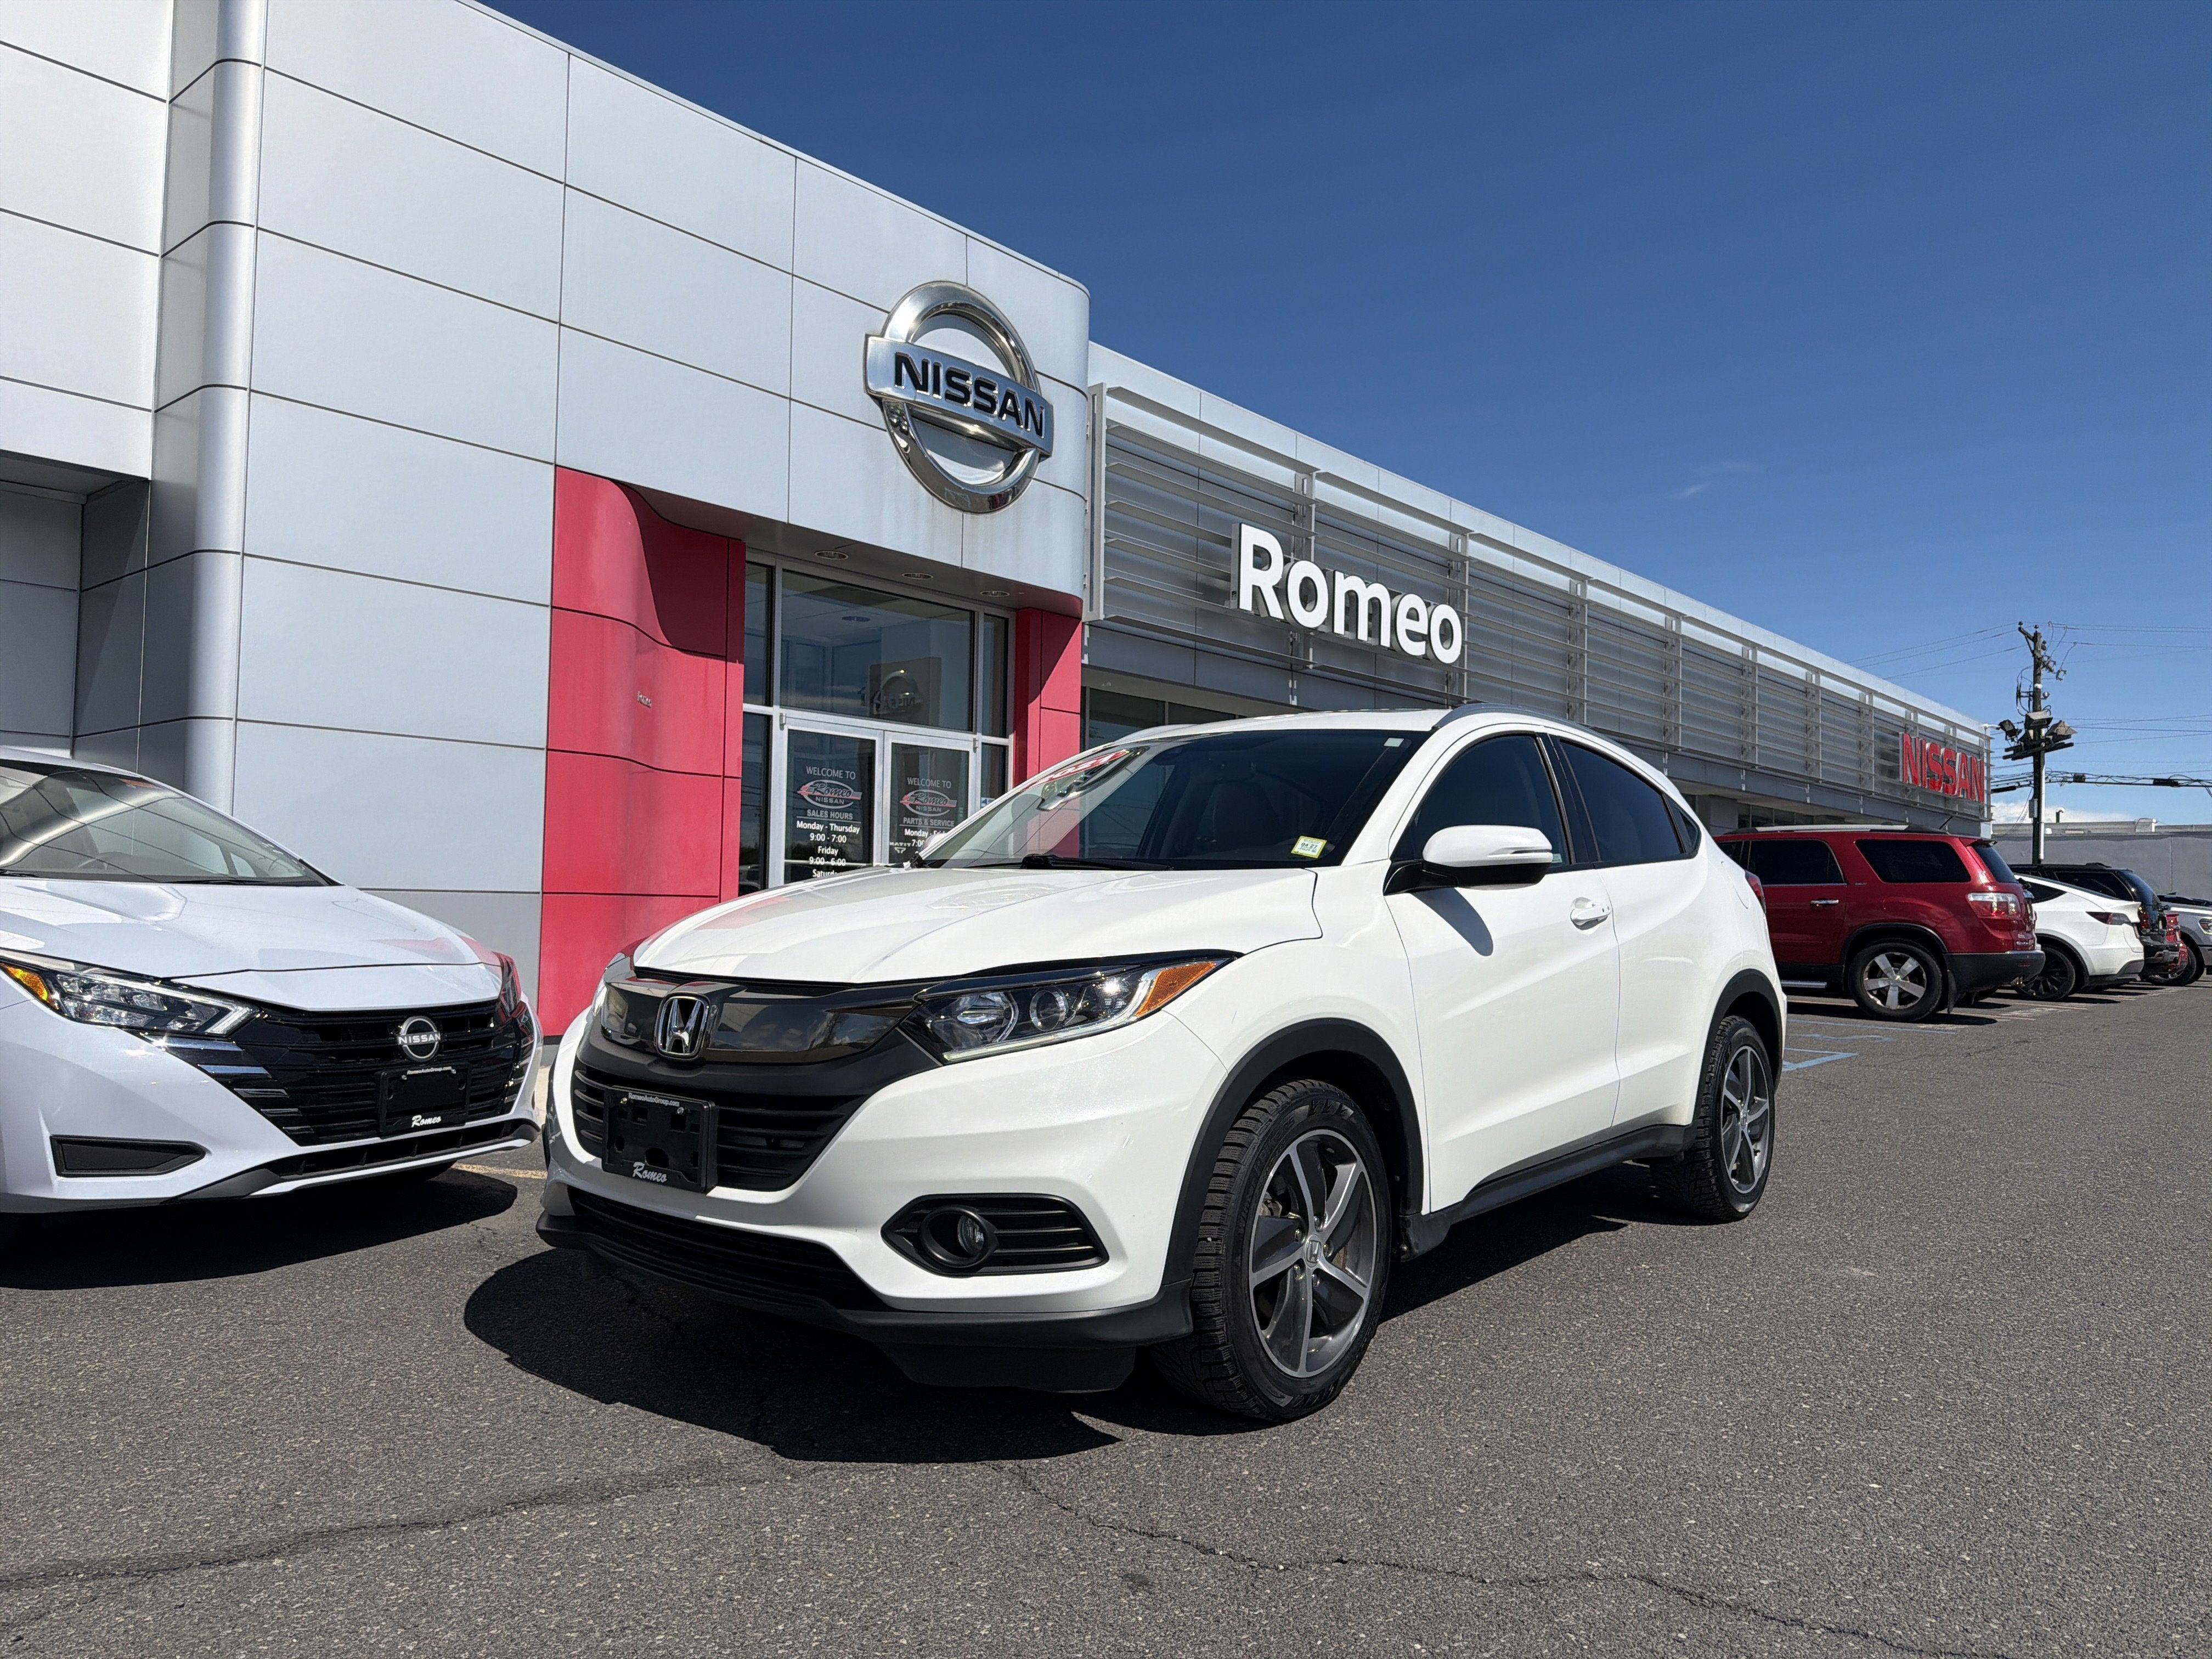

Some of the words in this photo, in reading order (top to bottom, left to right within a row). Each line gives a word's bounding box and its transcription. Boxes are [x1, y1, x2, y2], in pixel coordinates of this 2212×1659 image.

[894, 351, 1045, 439] NISSAN
[1238, 522, 1463, 664] Romeo
[806, 766, 843, 778] WELCOME
[845, 770, 856, 780] TO
[1902, 732, 1985, 803] NISSAN
[810, 781, 852, 798] Romeo
[907, 777, 940, 788] WELCOME
[941, 780, 952, 789] TO
[815, 797, 845, 805] NISSAN
[911, 791, 948, 805] Romeo
[806, 809, 828, 819] SALES
[830, 811, 853, 820] HOURS
[797, 820, 824, 832] Monday
[829, 823, 860, 834] Thursday
[903, 817, 923, 826] PARTS
[930, 819, 955, 827] SERVICE
[810, 832, 826, 841] 9:00
[831, 834, 847, 843] 7:00
[904, 828, 928, 838] Monday
[817, 846, 839, 856] Friday
[809, 856, 825, 865] 9:00
[831, 858, 847, 866] 6:00
[812, 868, 837, 878] Saturd
[398, 1033, 441, 1045] NISSAN
[628, 1092, 680, 1107] RomeoAutoGroup.com
[411, 1114, 442, 1128] Romeo
[631, 1161, 668, 1183] Romeo
